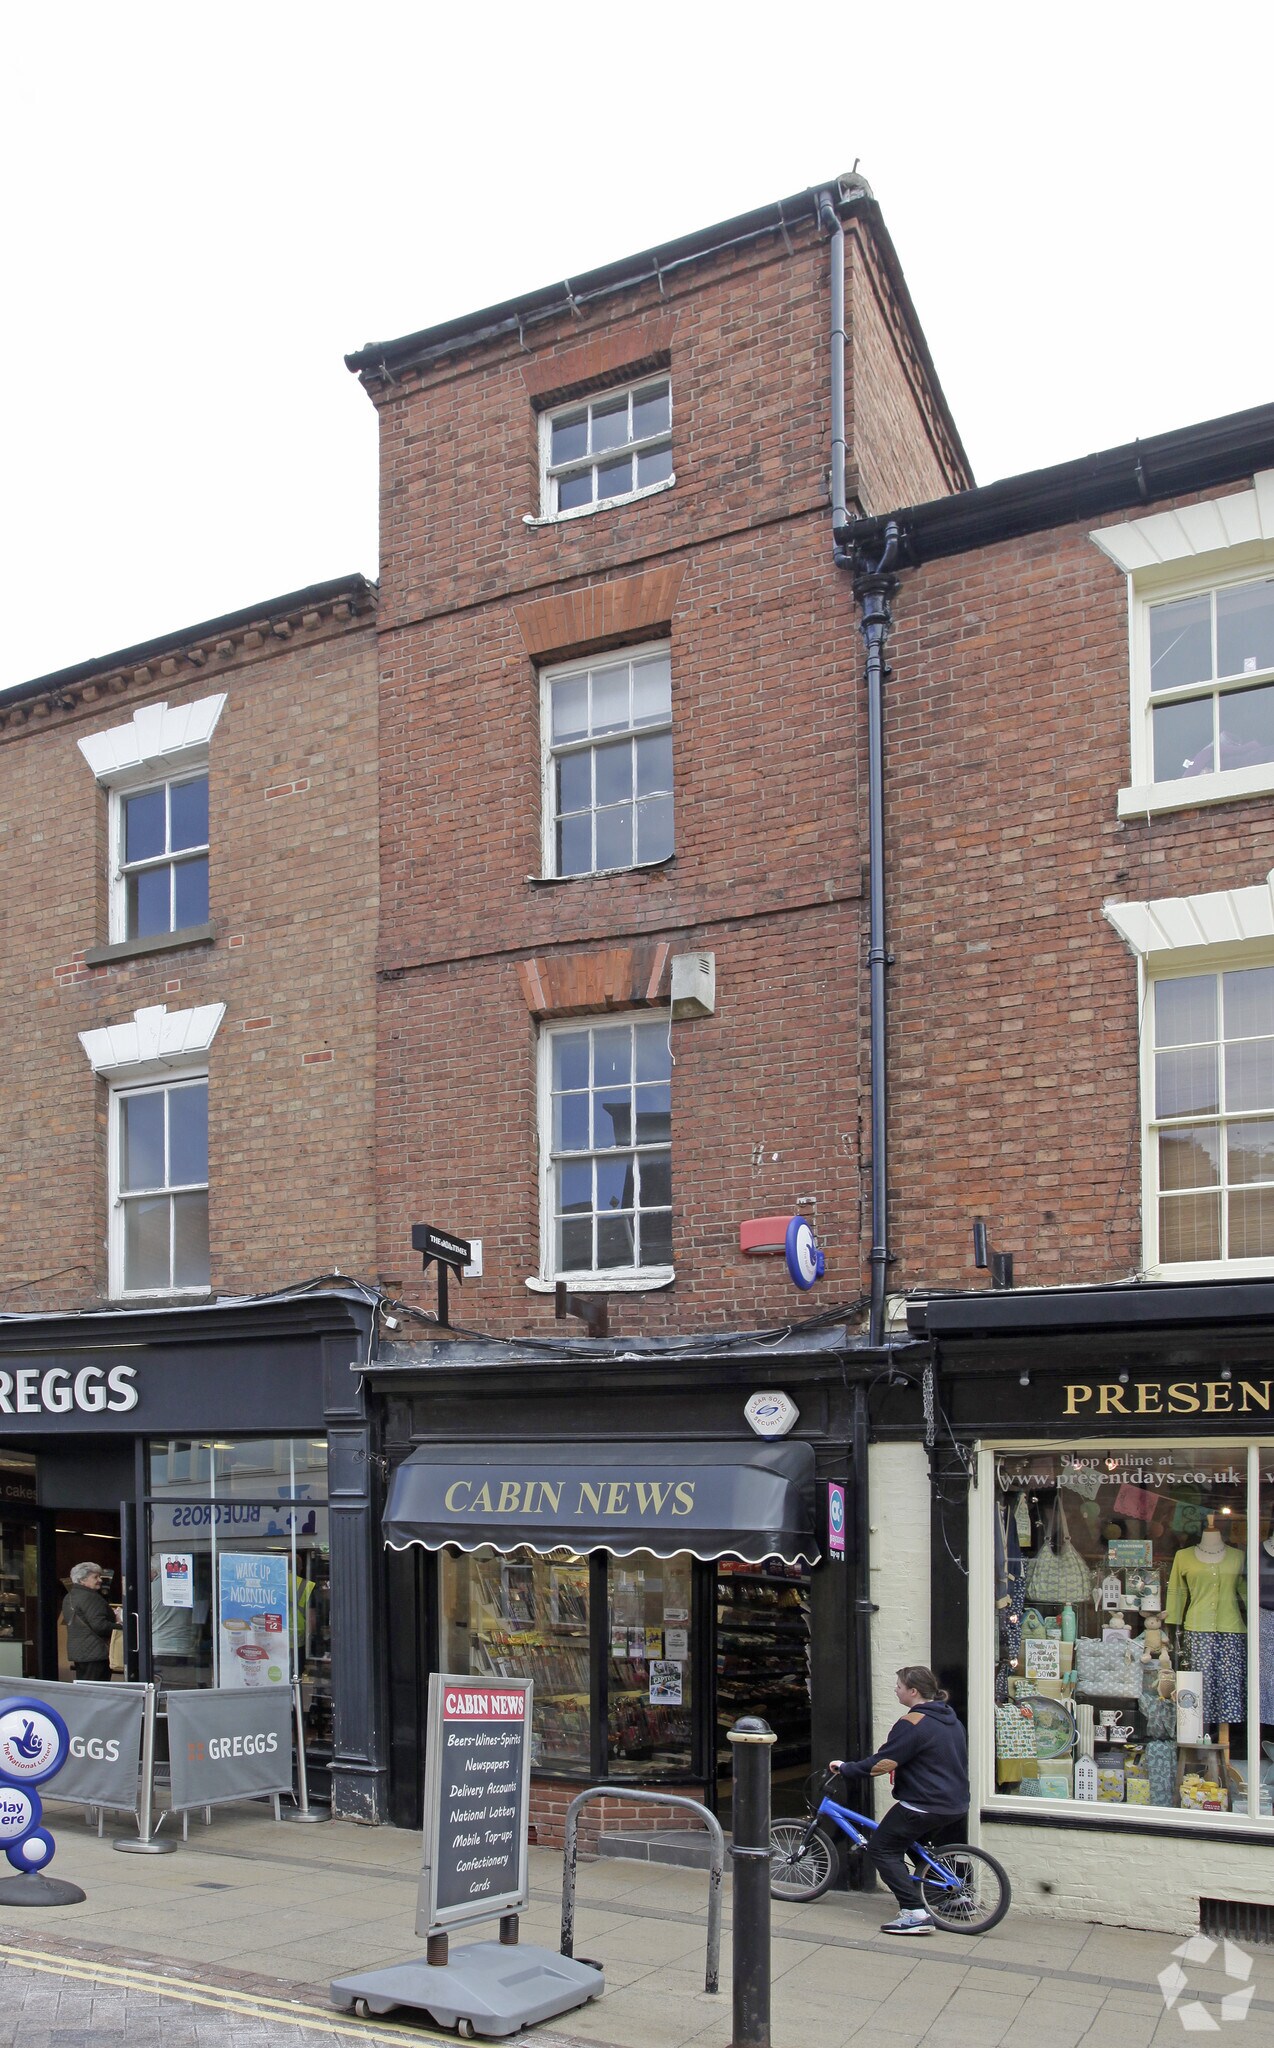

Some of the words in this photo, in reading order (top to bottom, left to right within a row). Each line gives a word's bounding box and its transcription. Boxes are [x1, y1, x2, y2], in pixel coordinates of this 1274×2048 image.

[430, 1235, 442, 1245] THE
[451, 1244, 468, 1257] TIMES
[750, 1397, 766, 1413] CLEAR
[769, 1396, 787, 1412] SOUND
[1062, 1381, 1274, 1413] PRESEN
[754, 1416, 784, 1426] SECURITY
[1060, 1454, 1100, 1468] Shop
[1105, 1454, 1153, 1467] online
[1159, 1455, 1174, 1467] at
[1000, 1467, 1241, 1488] www.presentdays.co.uk
[444, 1481, 566, 1512] CABIN
[574, 1482, 696, 1515] NEWS
[235, 1563, 259, 1580] WAKE
[260, 1565, 271, 1582] UP
[230, 1585, 277, 1605] MORNING
[446, 1694, 488, 1714] CABIN
[491, 1695, 524, 1715] NEWS
[208, 1732, 278, 1760] GREGGS
[447, 1732, 521, 1748] Beers-Wines-Spirits
[8, 1755, 37, 1769] National
[38, 1742, 52, 1765] Lottery
[465, 1758, 510, 1773] Newspapers
[449, 1784, 484, 1798] Delivery
[487, 1782, 517, 1794] Accounts
[0, 1801, 23, 1814] lay
[450, 1807, 486, 1823] National
[489, 1806, 516, 1818] Lottery
[452, 1832, 481, 1848] Mobile
[485, 1831, 513, 1845] Top-ups
[456, 1855, 509, 1872] Confectionery
[469, 1878, 491, 1893] Cards
